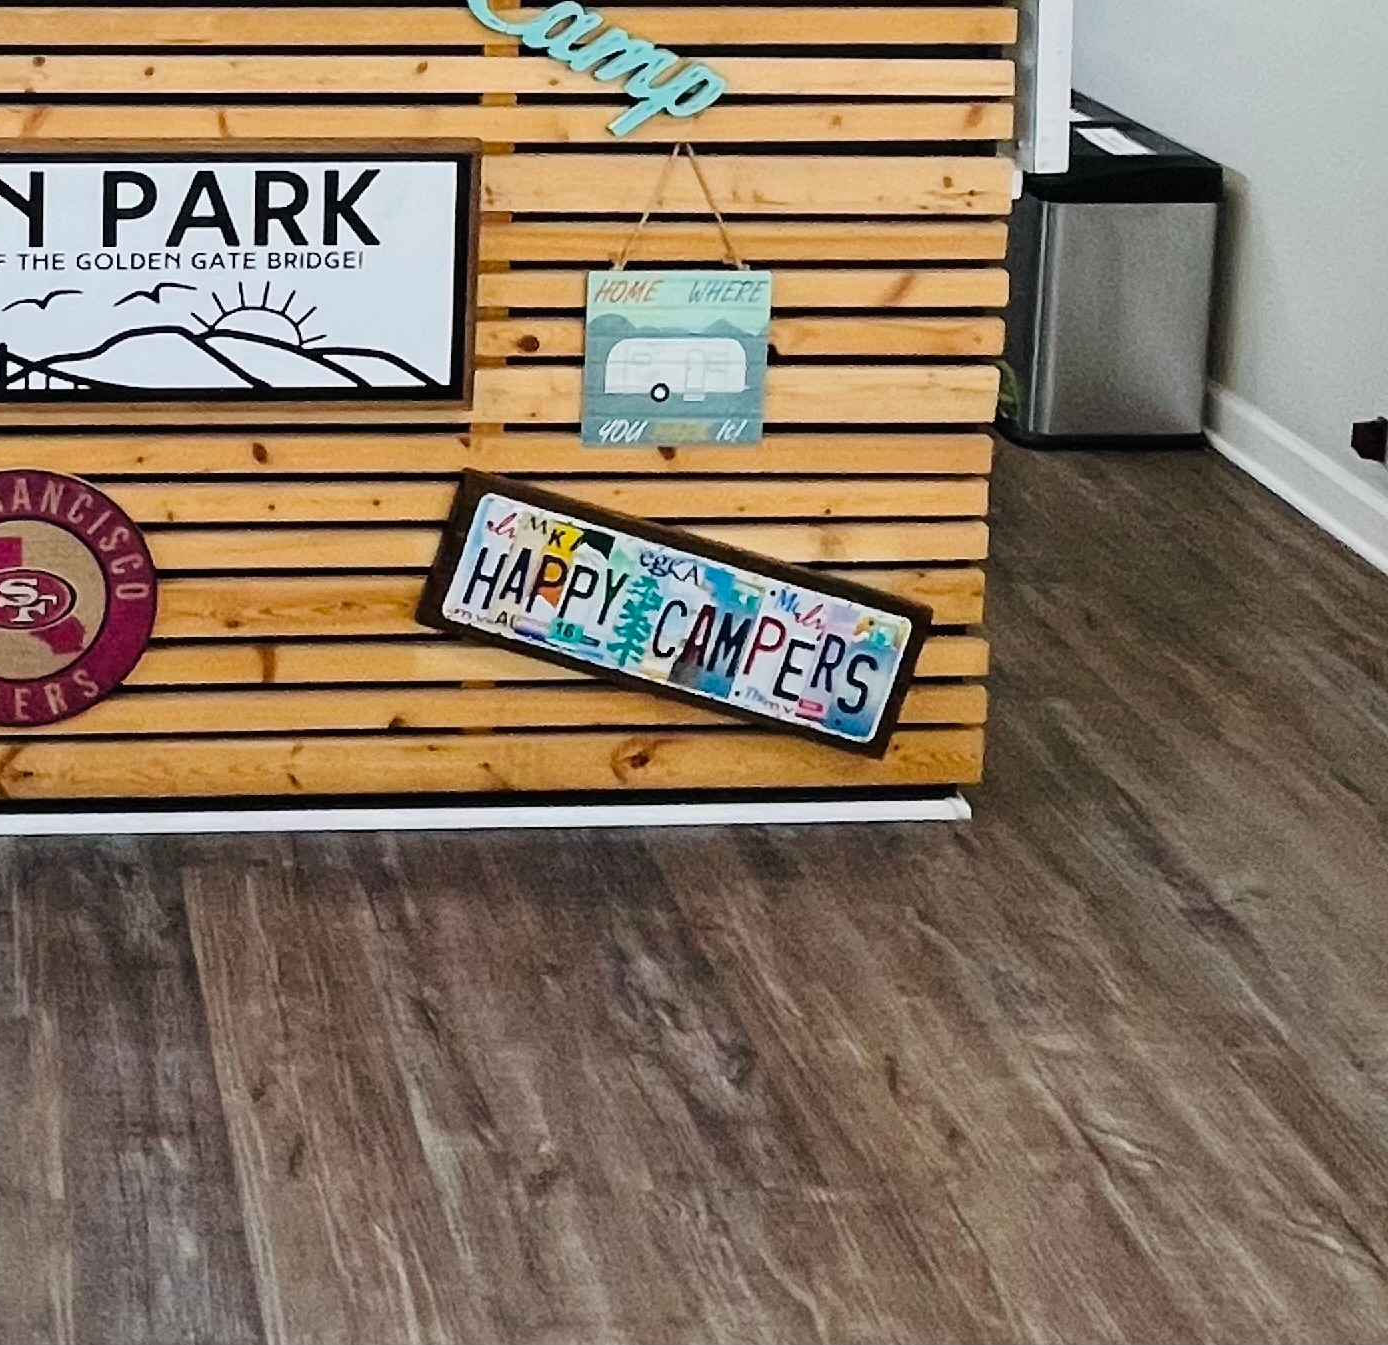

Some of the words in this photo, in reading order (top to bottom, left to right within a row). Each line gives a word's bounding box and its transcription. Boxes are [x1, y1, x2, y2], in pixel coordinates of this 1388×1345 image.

[102, 168, 381, 248] PARK
[18, 253, 66, 271] THE
[76, 252, 182, 271] GOLDEN
[191, 252, 257, 270] GATE
[267, 250, 364, 270] BRIDGE!
[593, 279, 665, 304] HOME
[687, 280, 769, 304] WHERE
[598, 419, 649, 443] YOU
[462, 547, 630, 626] HAPPY
[652, 599, 879, 715] CAMPERS
